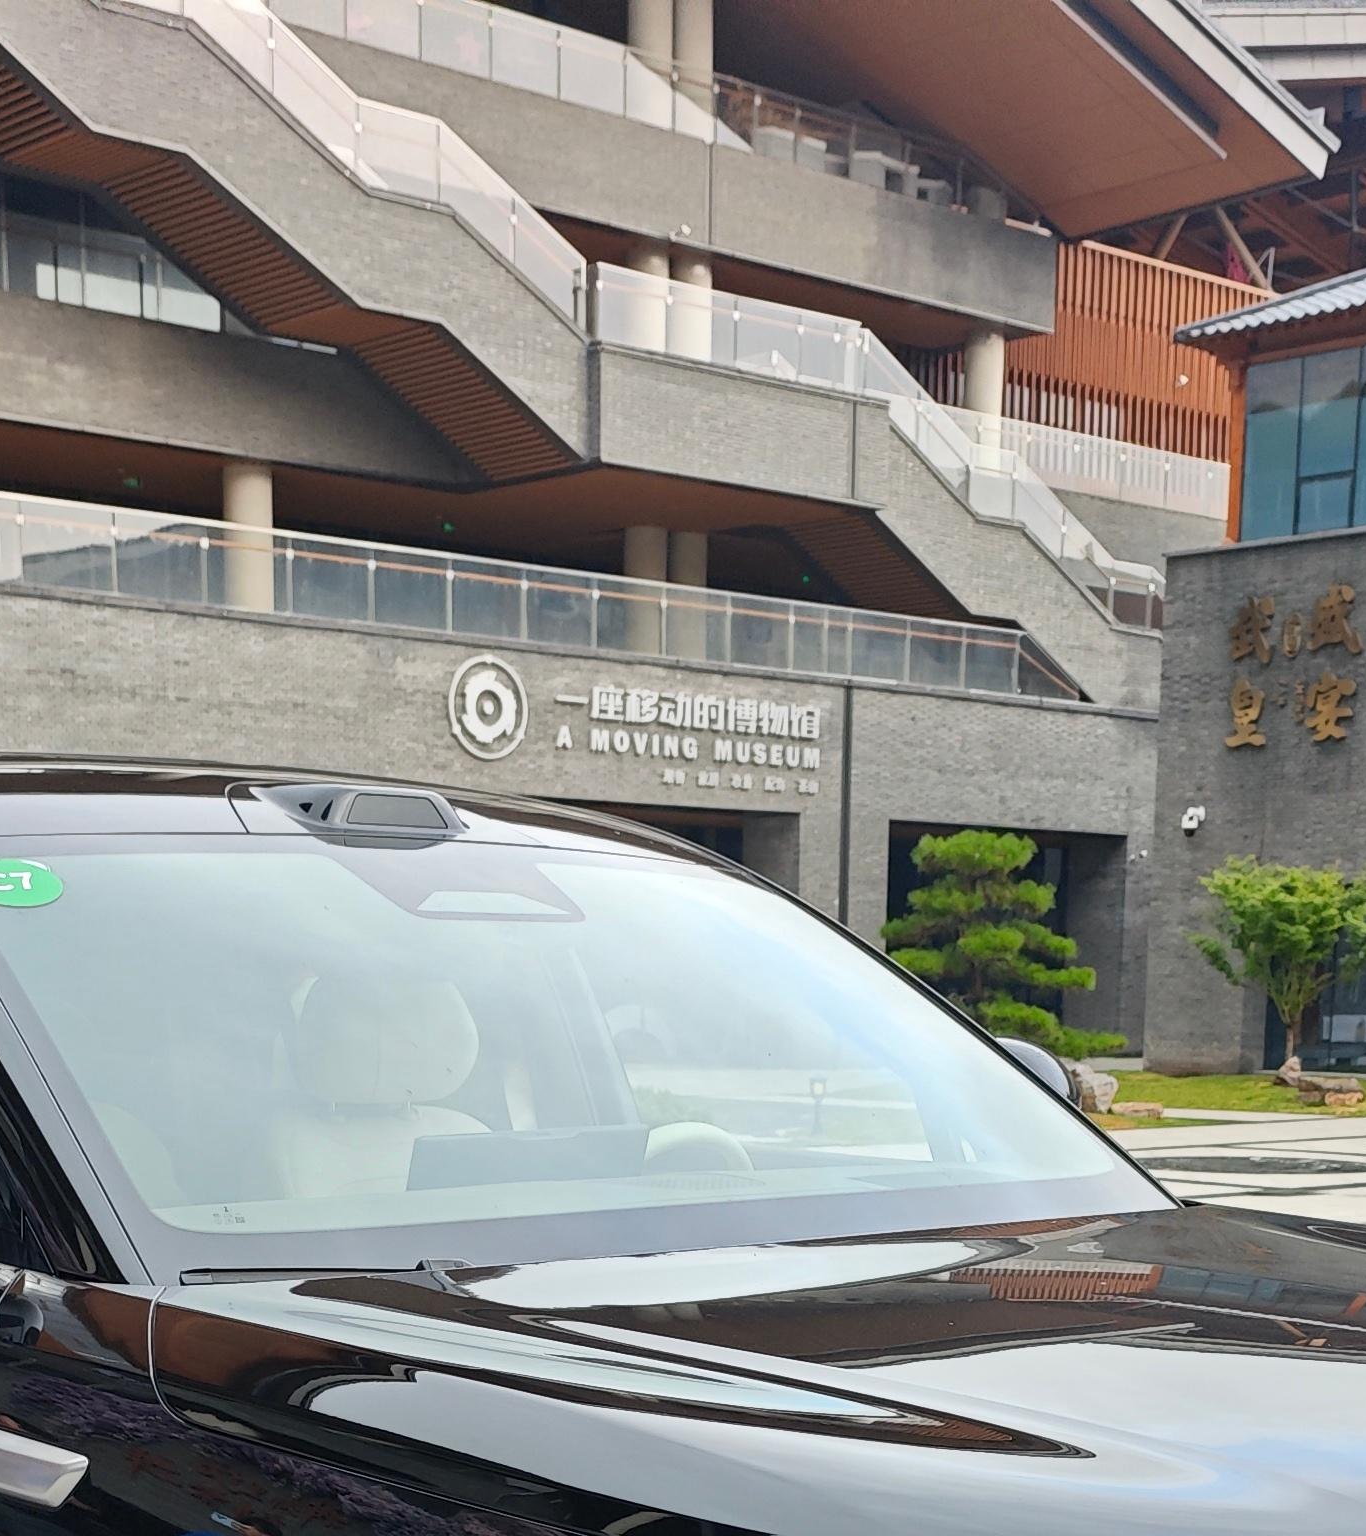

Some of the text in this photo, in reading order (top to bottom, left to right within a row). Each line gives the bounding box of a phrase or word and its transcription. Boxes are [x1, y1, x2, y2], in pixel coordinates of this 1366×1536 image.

[554, 684, 821, 741] 一座移动的博物馆
[555, 724, 821, 769] A MOVING MUSEUM
